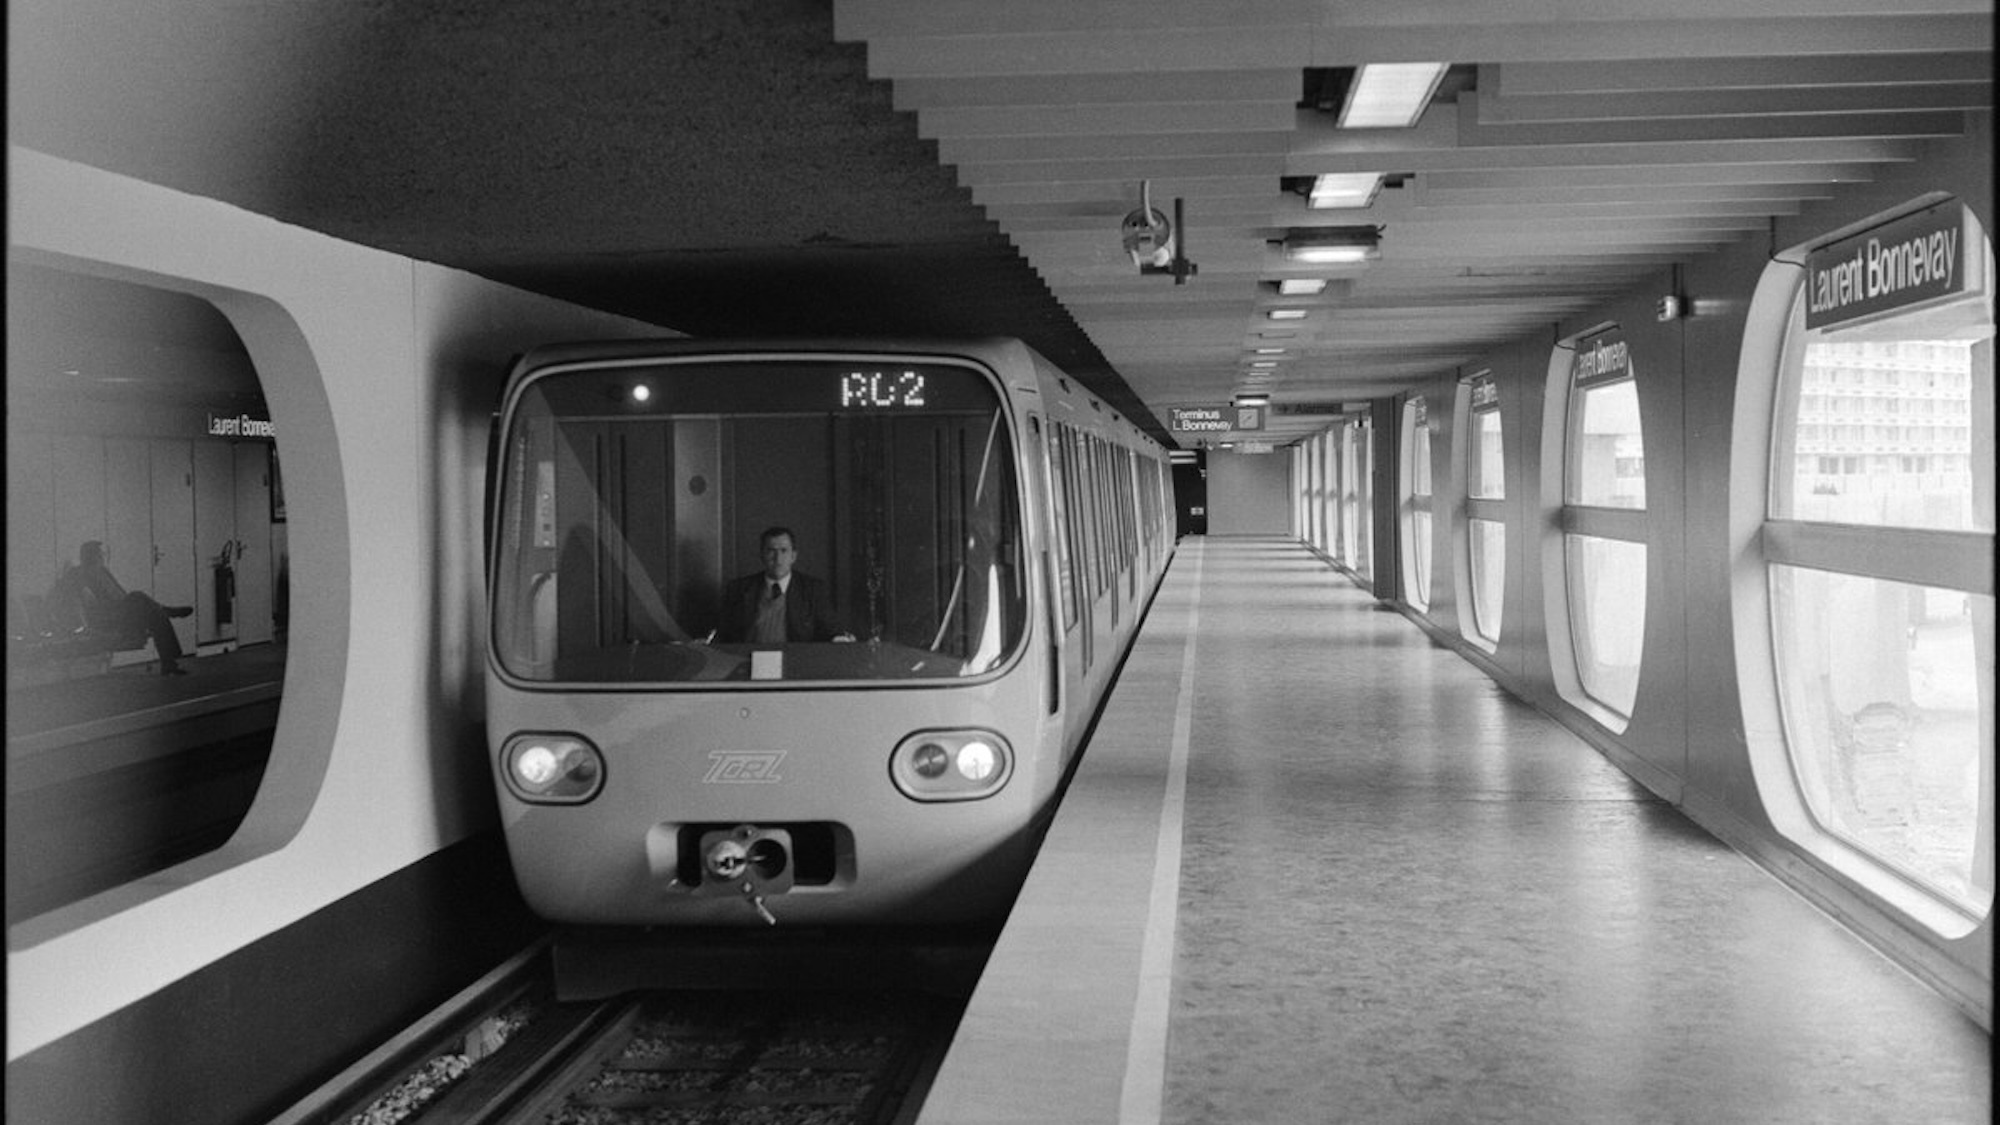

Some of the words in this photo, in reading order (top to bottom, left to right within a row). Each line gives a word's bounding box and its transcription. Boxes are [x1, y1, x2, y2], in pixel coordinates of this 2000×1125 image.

[1810, 247, 1864, 313] Laurent
[1867, 227, 1958, 298] Bonnevay
[1173, 408, 1220, 419] Terminus
[207, 412, 240, 436] Laurent
[241, 413, 277, 437] Bonneva
[1182, 419, 1233, 432] Bonnevay
